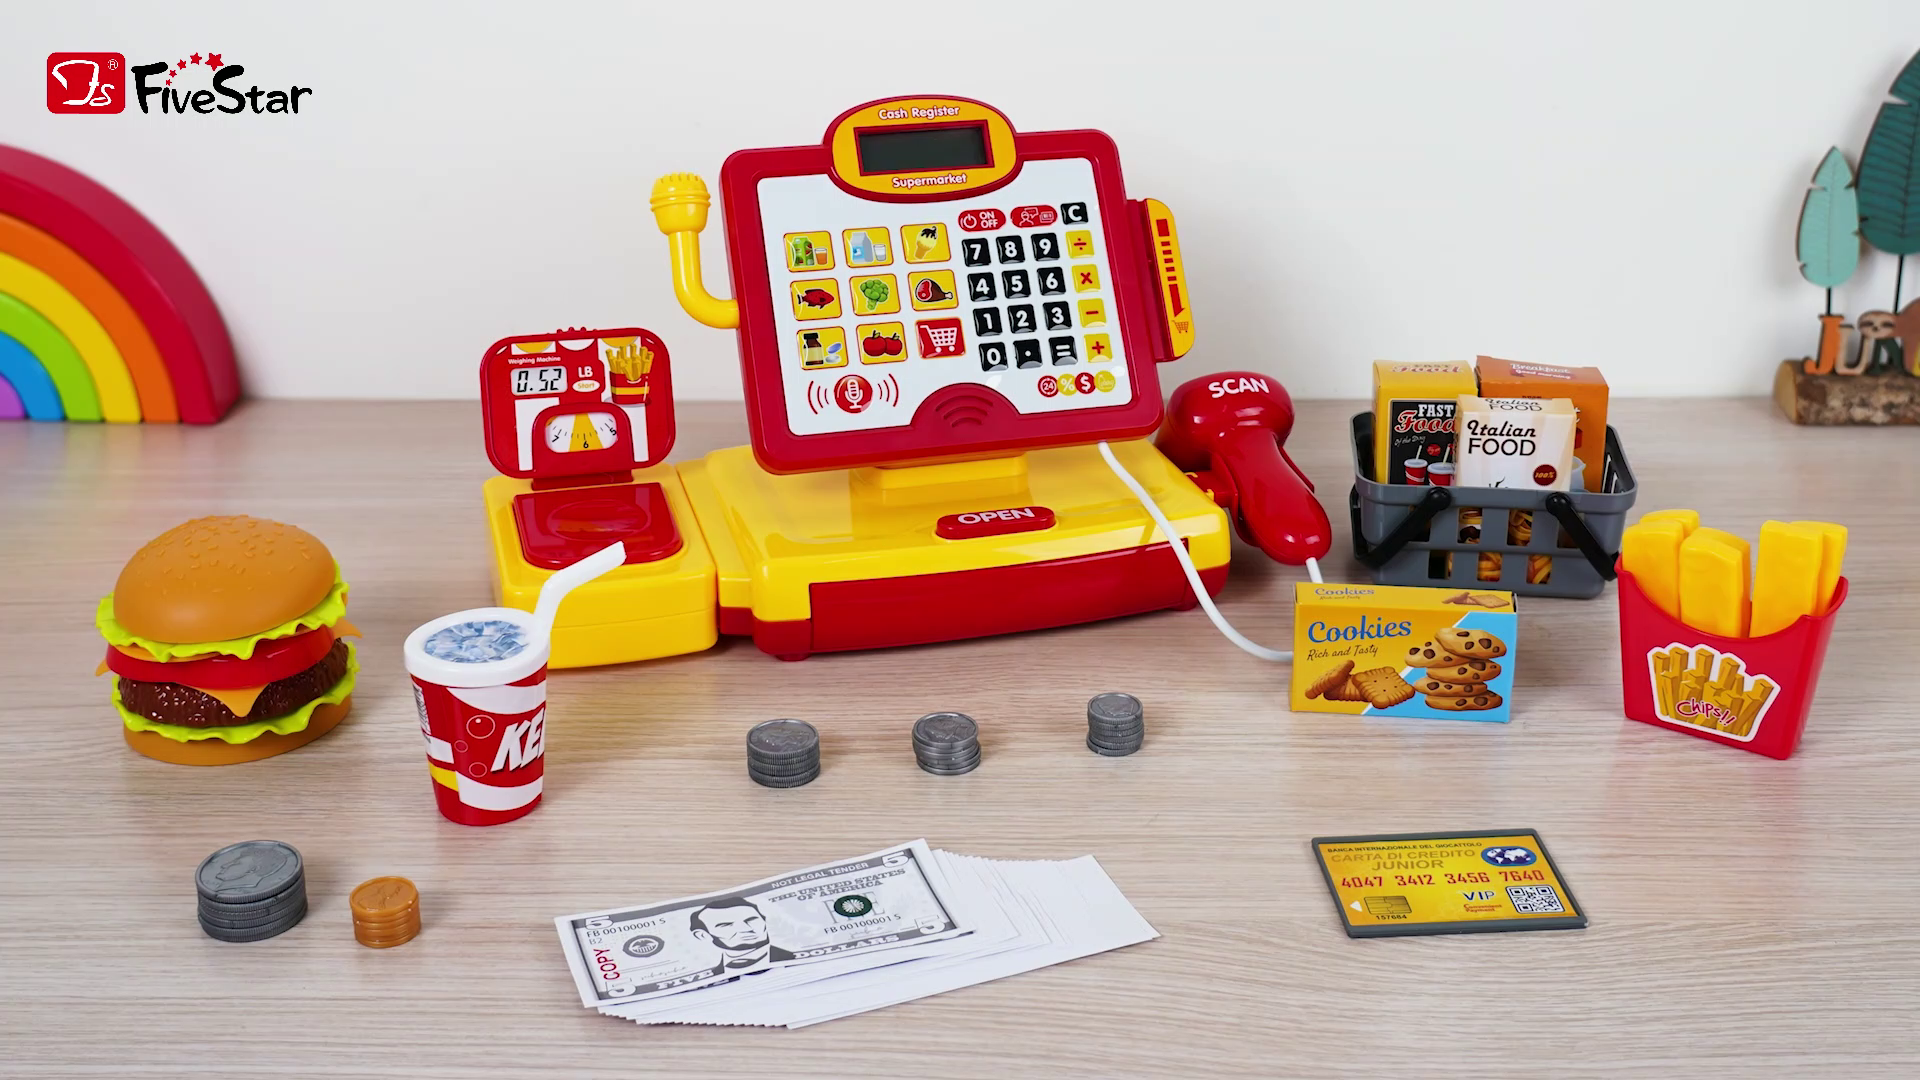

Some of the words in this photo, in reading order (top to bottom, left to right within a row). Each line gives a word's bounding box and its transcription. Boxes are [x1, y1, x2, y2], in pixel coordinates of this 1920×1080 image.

[878, 108, 908, 120] Cash
[911, 106, 960, 120] Register
[892, 173, 967, 189] Supermarket
[979, 211, 995, 219] ON
[1068, 205, 1082, 221] C
[981, 219, 998, 228] OFF
[970, 243, 981, 260] 7
[1005, 241, 1017, 258] 8
[1039, 239, 1051, 255] 9
[976, 278, 990, 294] 4
[1011, 275, 1023, 292] 5
[1046, 272, 1058, 289] 6
[983, 313, 993, 329] 1
[1017, 310, 1030, 327] 2
[1052, 307, 1064, 324] 3
[508, 357, 535, 365] Weighing
[987, 348, 1000, 364] 0
[577, 366, 593, 378] LB
[1510, 363, 1571, 374] Breakfast
[516, 368, 562, 393] 0.52
[1043, 382, 1054, 391] 24
[1208, 377, 1270, 399] SCAN
[1418, 404, 1453, 417] FAST
[1394, 410, 1456, 433] Food
[1467, 420, 1537, 438] Italian
[583, 441, 588, 449] 6
[1468, 438, 1536, 456] FOOD
[1535, 471, 1554, 479] 100%
[957, 507, 1035, 525] OPEN
[1315, 587, 1375, 596] Cookies
[1308, 615, 1412, 643] Cookies
[1307, 648, 1329, 661] Rich
[1332, 647, 1350, 656] and
[1352, 645, 1379, 657] Tasty
[1676, 698, 1736, 726] Chips!!
[1331, 853, 1383, 863] CARTA
[1387, 852, 1402, 860] DI
[1407, 849, 1475, 859] CREDITO
[1355, 844, 1417, 852] INTERNAZIONALE
[882, 851, 909, 868] 5
[1371, 860, 1444, 871] JUNIOR
[771, 879, 793, 889] NOT
[795, 871, 827, 883] LEGAL
[829, 862, 869, 877] TENDER
[1341, 876, 1383, 888] 4047
[1395, 874, 1435, 886] 3412
[1444, 872, 1490, 884] 3456
[1499, 869, 1545, 882] 7640
[768, 891, 797, 903] THE
[799, 880, 853, 896] UNITED
[854, 868, 906, 883] STATES
[797, 893, 816, 902] OF
[820, 880, 883, 898] AMERICA
[1462, 890, 1496, 901] VIP
[585, 915, 614, 930] 5
[586, 930, 600, 938] FB
[602, 921, 656, 936] 00100001
[824, 925, 838, 934] FB
[840, 915, 892, 931] 00100001
[894, 913, 901, 921] S
[593, 948, 620, 981] COPY
[656, 969, 714, 990] FIVE
[793, 934, 899, 960] DOLLARS
